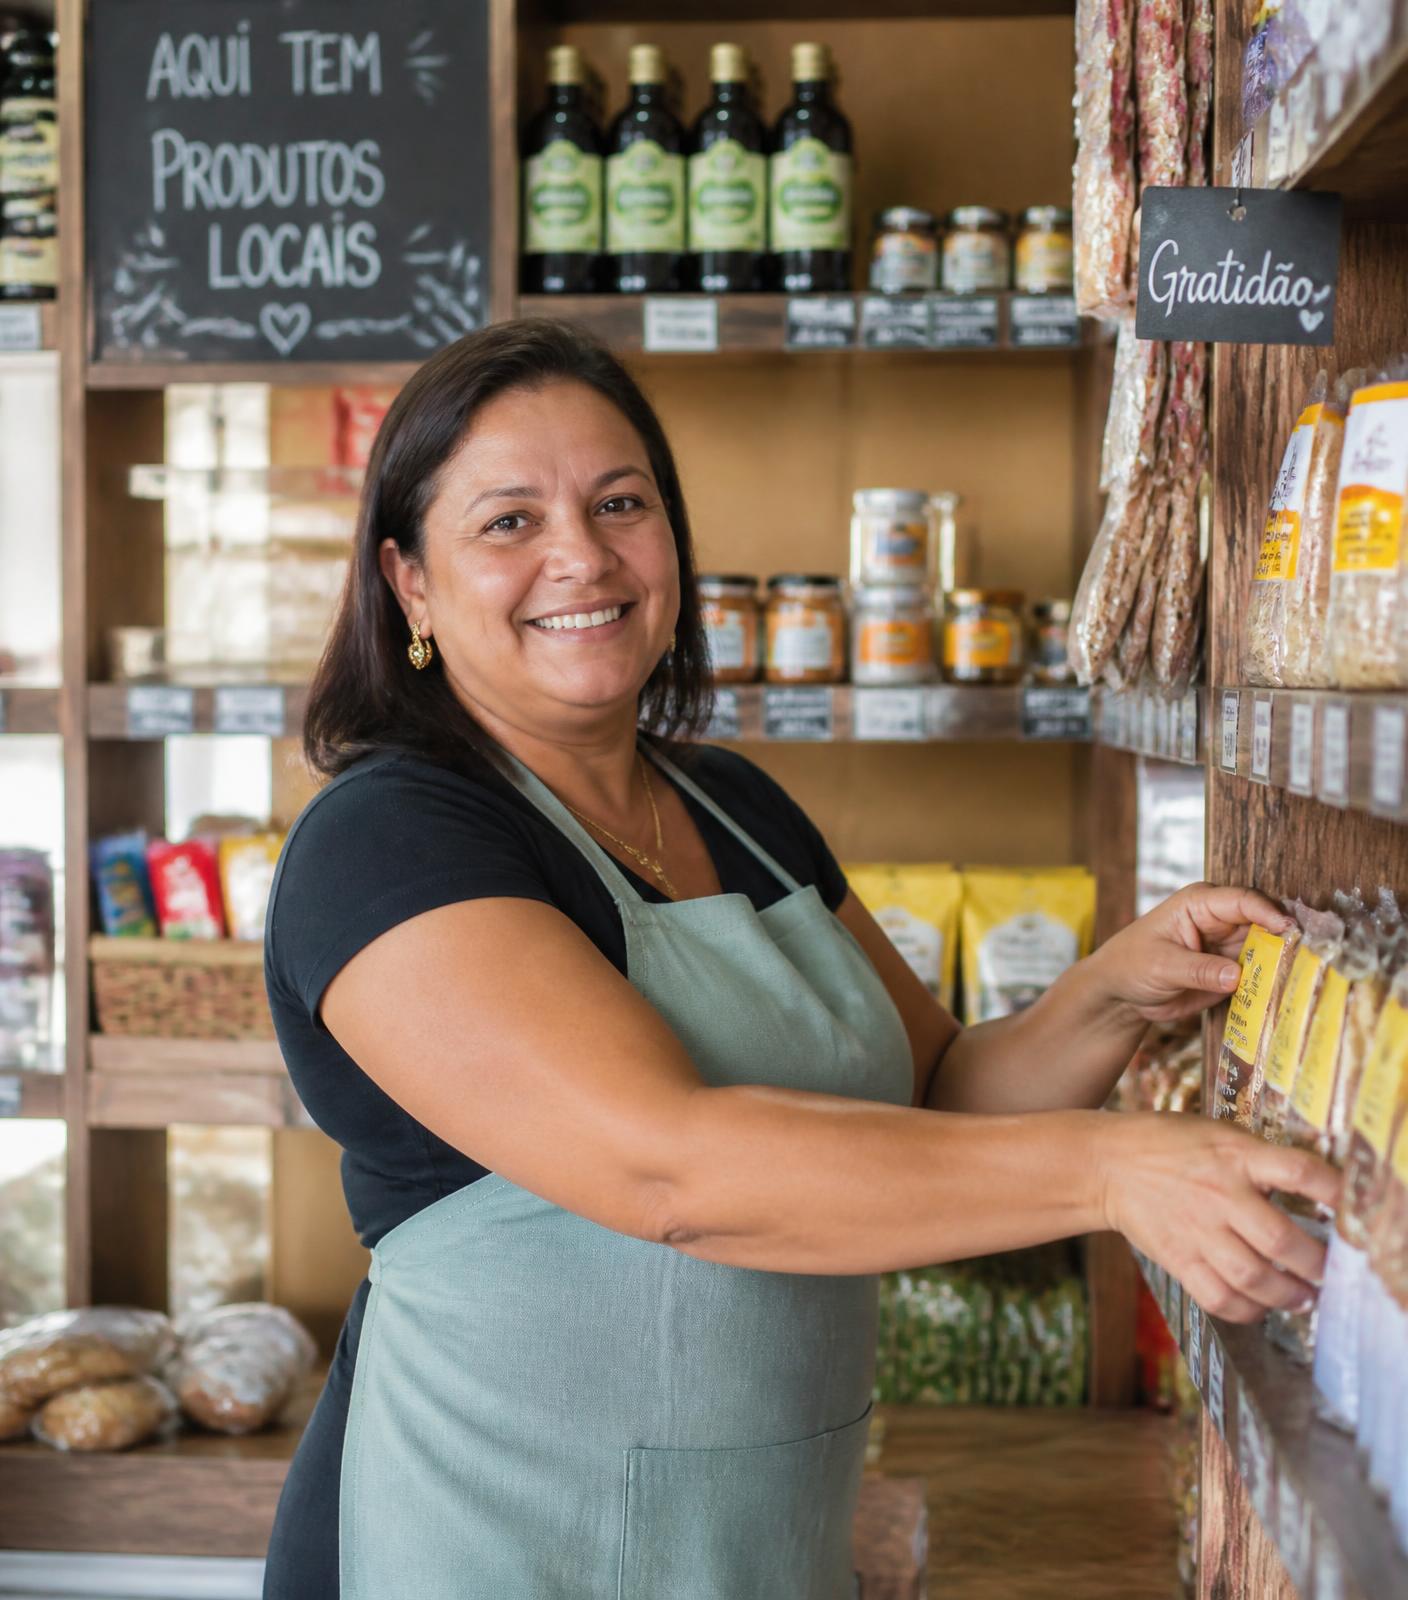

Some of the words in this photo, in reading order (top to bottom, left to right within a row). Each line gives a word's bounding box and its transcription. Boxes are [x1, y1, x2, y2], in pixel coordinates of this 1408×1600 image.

[147, 20, 251, 100] AQUI
[279, 30, 382, 96] TEM
[152, 128, 386, 212] PRODUTOS
[208, 210, 382, 290] LOCAIS
[1148, 238, 1314, 318] Gratidão
